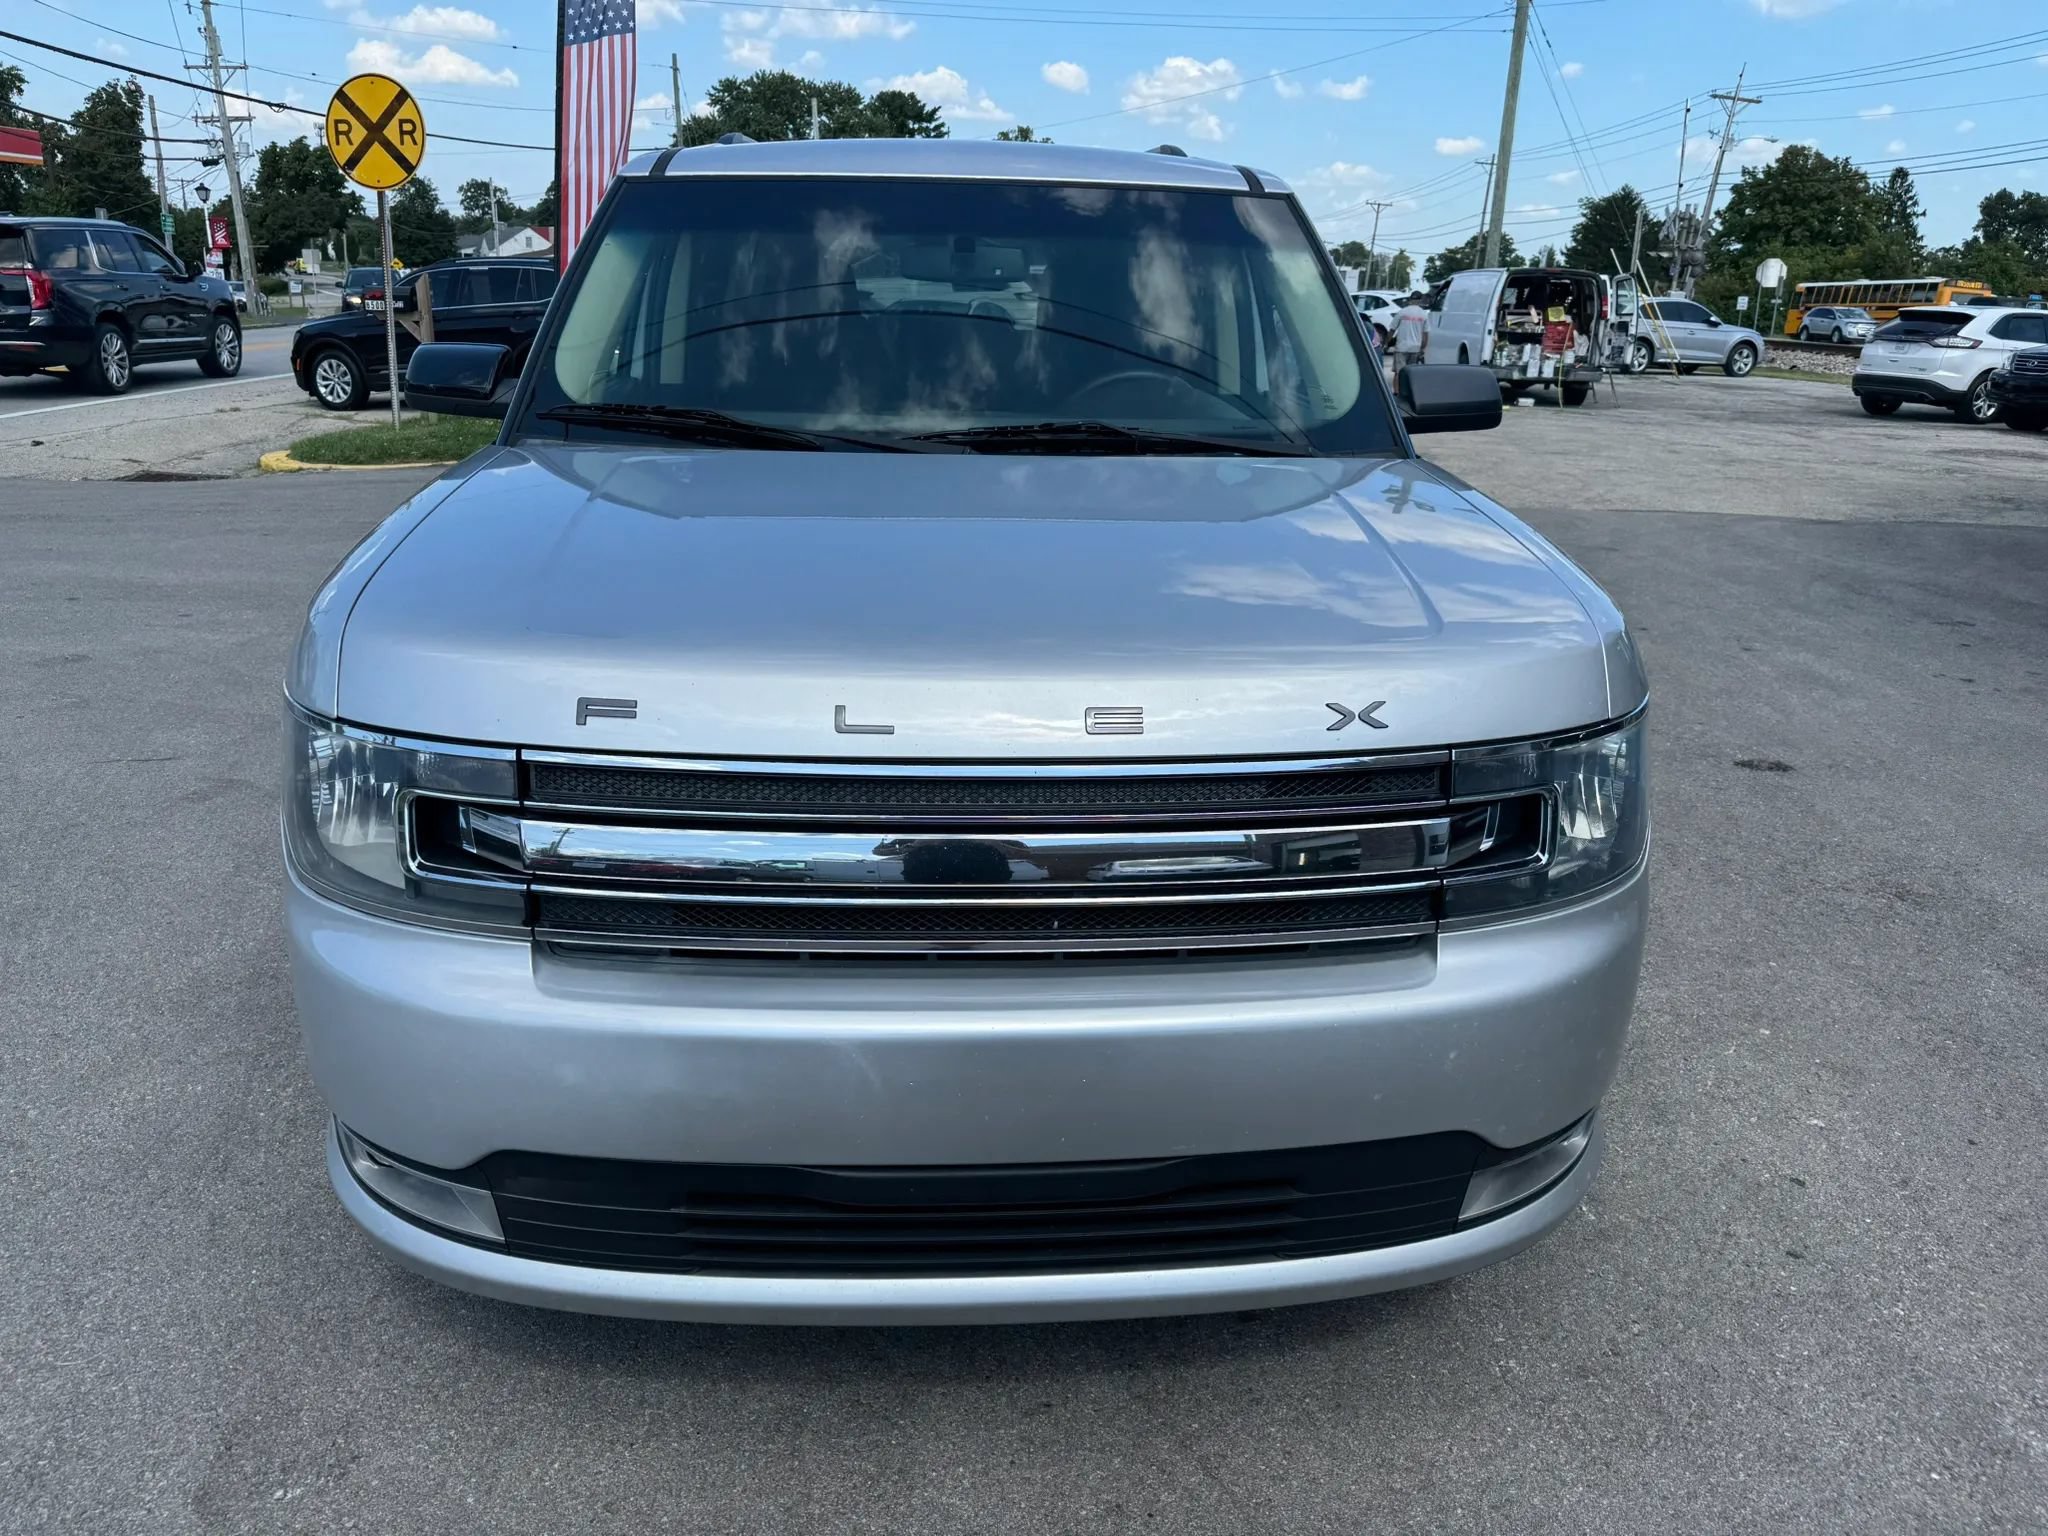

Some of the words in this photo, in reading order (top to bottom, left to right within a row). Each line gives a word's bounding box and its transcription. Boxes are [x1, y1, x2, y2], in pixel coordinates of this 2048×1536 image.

[333, 118, 354, 146] R
[398, 118, 418, 146] R
[576, 697, 1389, 735] FLEX
